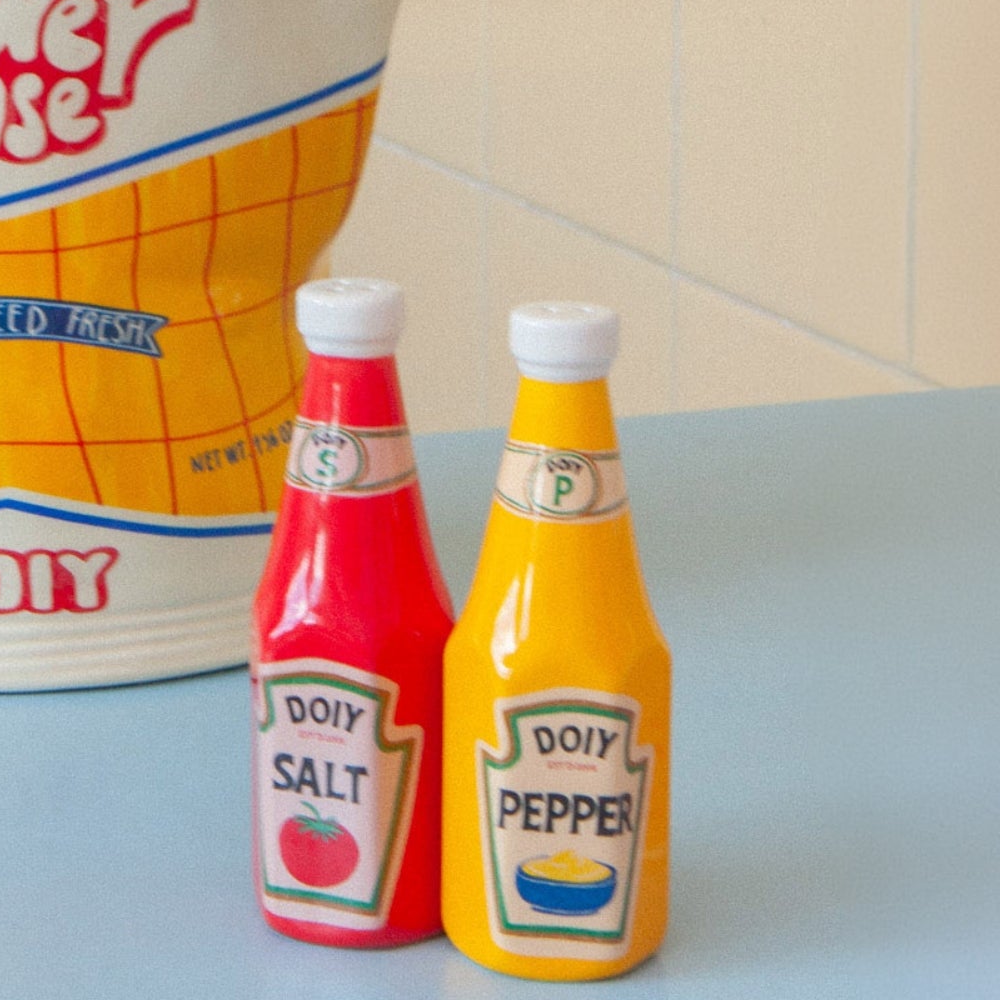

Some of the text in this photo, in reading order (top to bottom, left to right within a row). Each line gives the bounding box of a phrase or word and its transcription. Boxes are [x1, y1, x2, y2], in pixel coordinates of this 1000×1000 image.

[66, 304, 148, 346] FRESH
[317, 448, 338, 477] S
[553, 474, 574, 506] P
[284, 694, 366, 734] DOIY
[532, 725, 619, 760] DOIY
[272, 752, 370, 805] SALT
[497, 788, 633, 837] PEPPER
